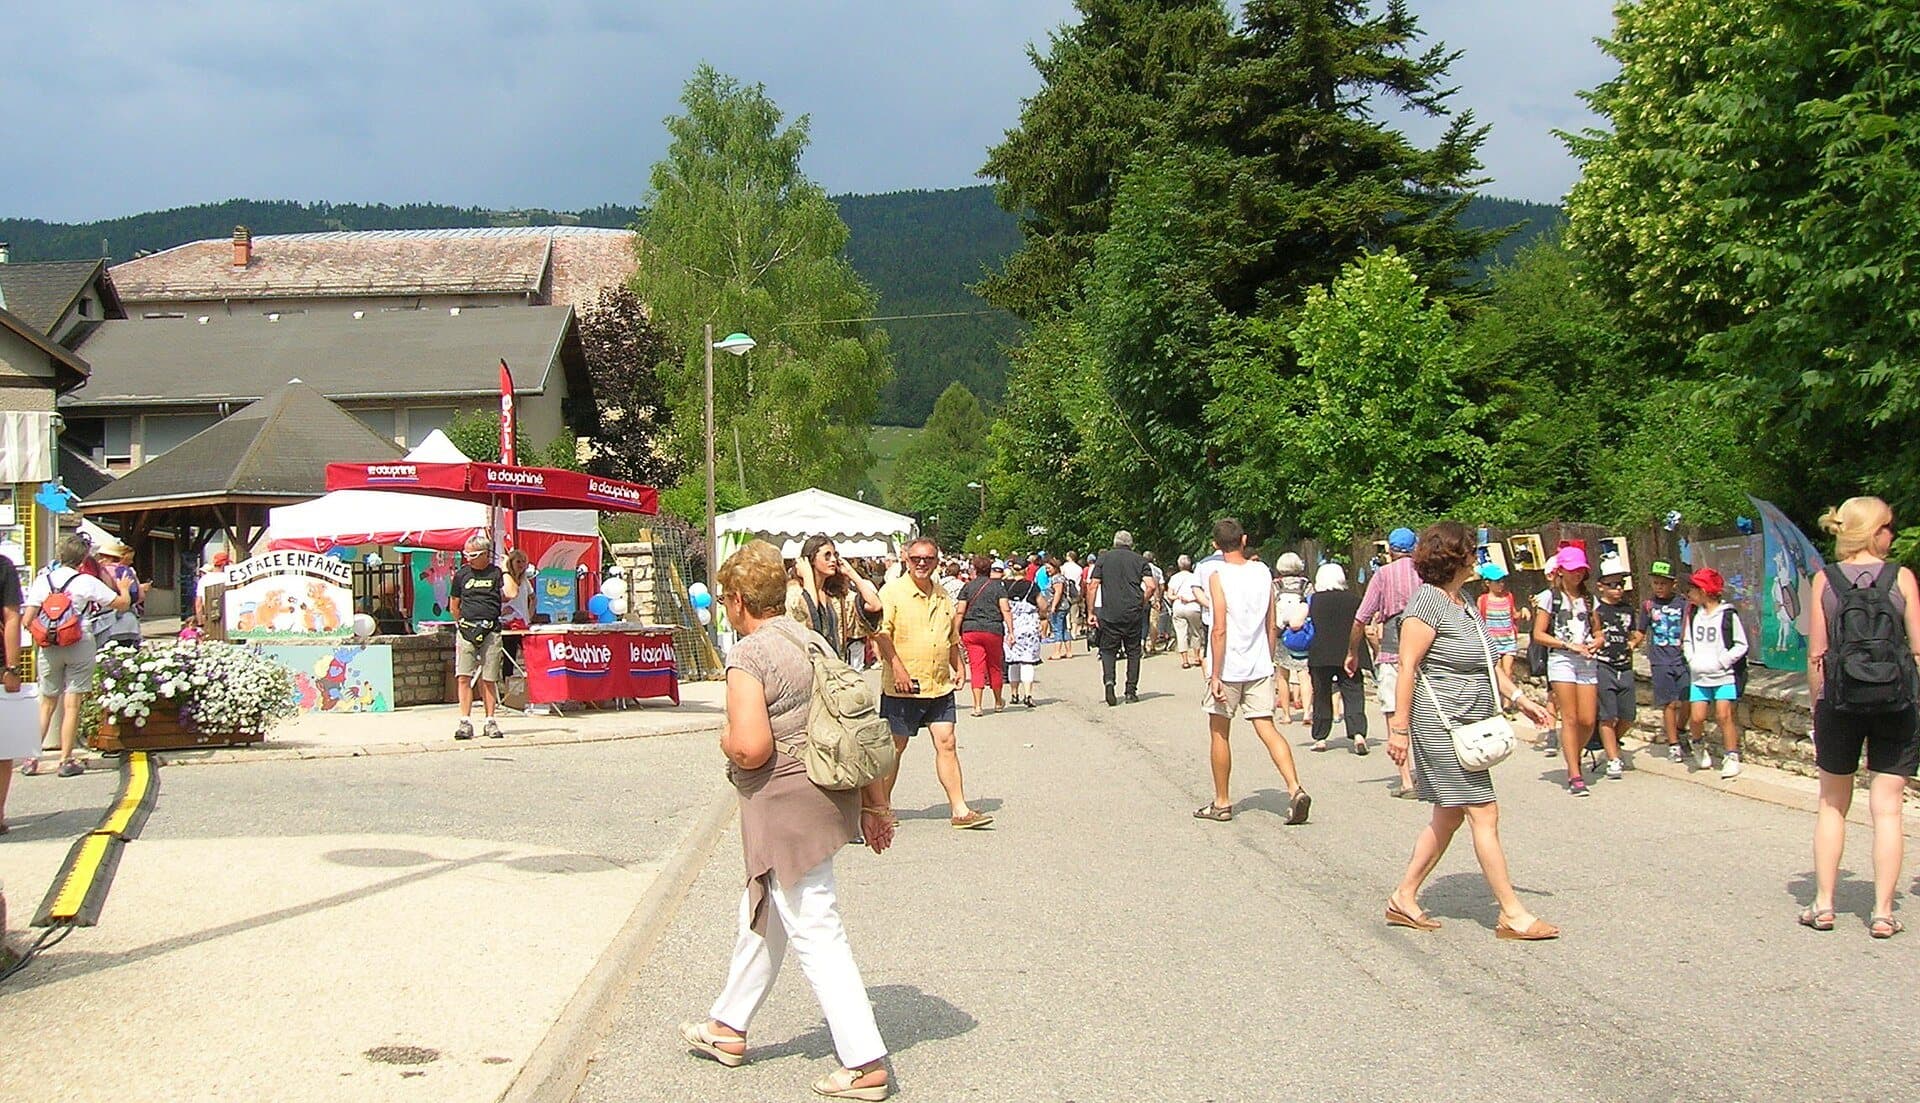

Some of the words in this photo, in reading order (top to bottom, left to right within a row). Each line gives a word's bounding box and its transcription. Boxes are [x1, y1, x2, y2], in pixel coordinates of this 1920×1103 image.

[487, 467, 497, 481] le
[498, 469, 544, 485] dauphiné
[588, 479, 598, 492] le
[598, 483, 641, 500] dauphiné
[229, 553, 283, 583] ESPACE
[287, 552, 351, 579] ENFANCE
[548, 639, 566, 662] le
[629, 642, 641, 663] le
